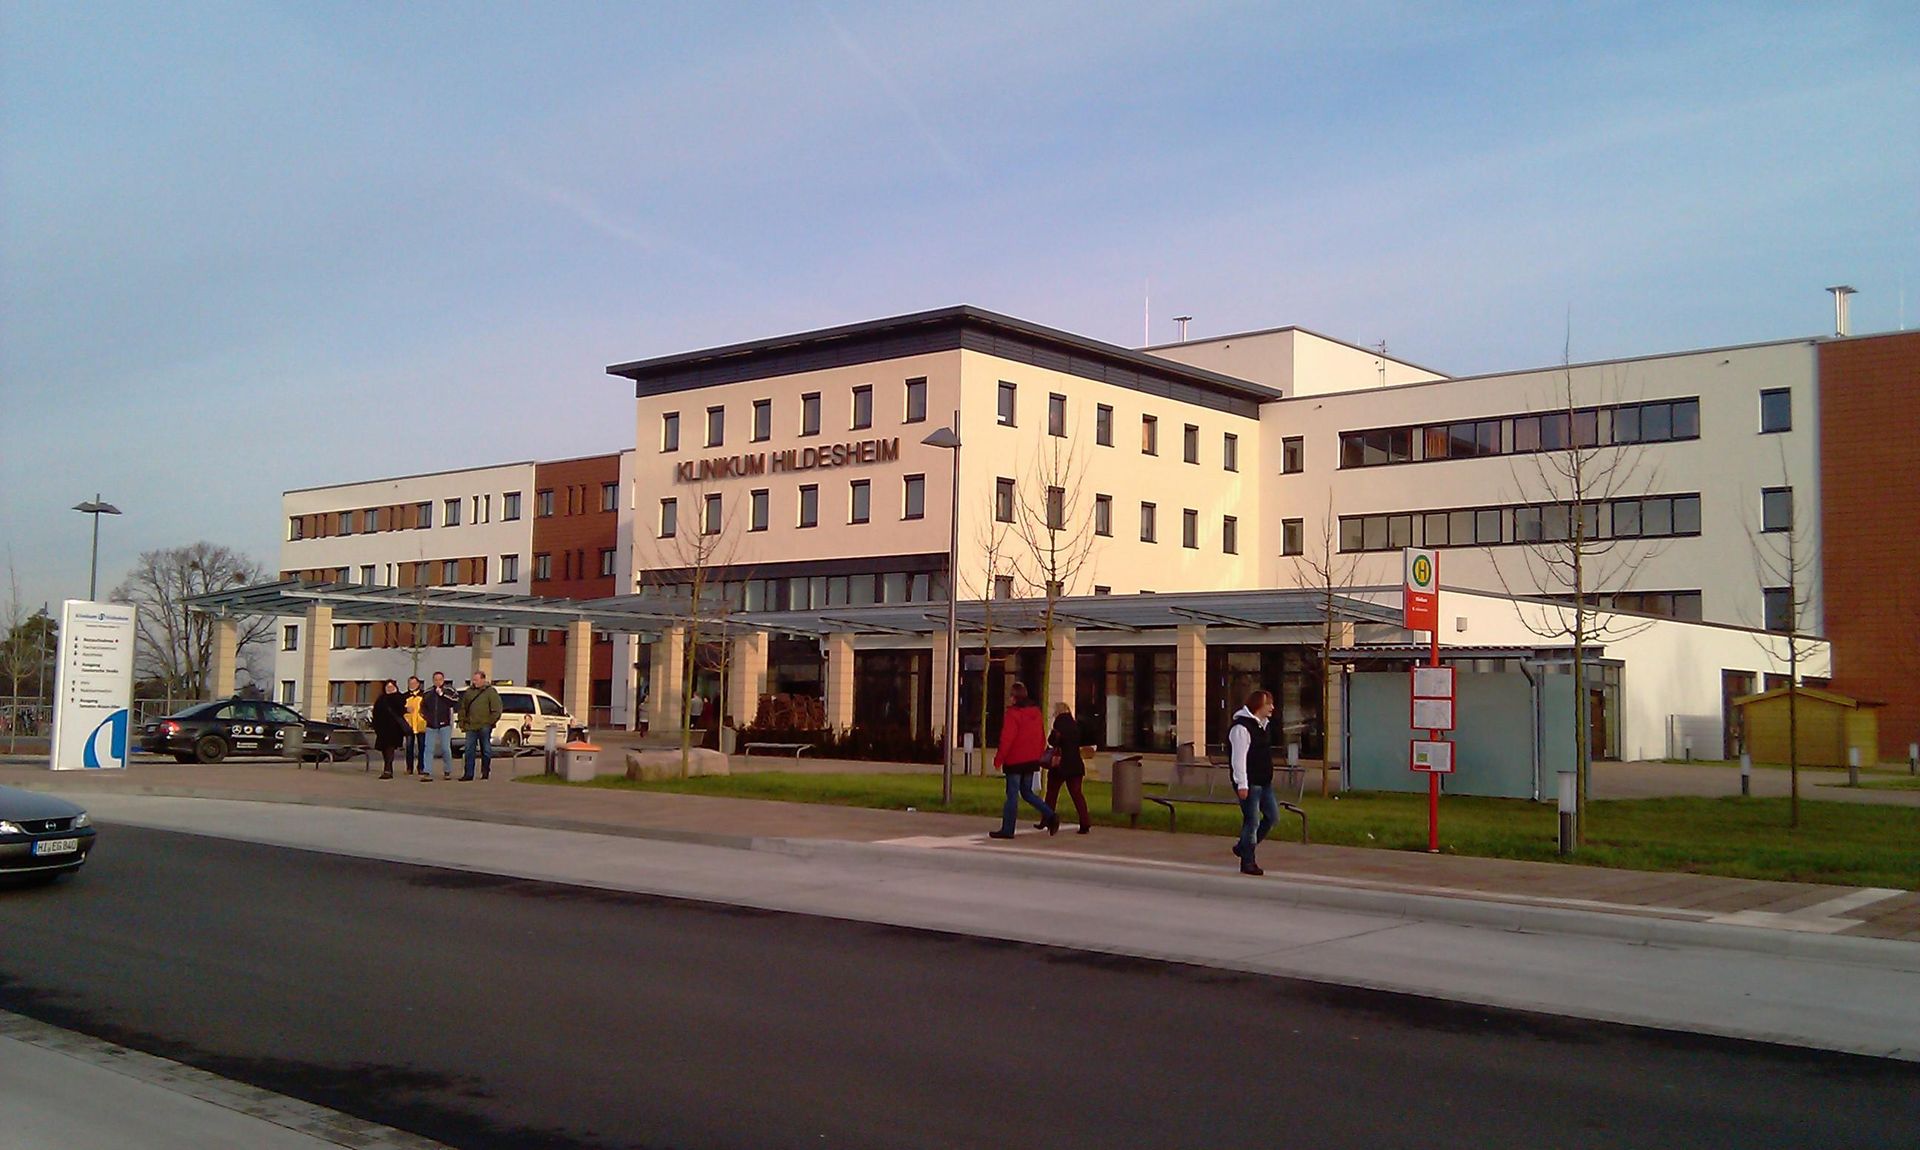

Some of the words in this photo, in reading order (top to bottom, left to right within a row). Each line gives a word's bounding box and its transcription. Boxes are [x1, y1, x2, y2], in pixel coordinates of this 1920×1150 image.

[677, 453, 766, 483] KLINIKUM
[772, 437, 900, 473] HILDESHEIM
[1417, 560, 1427, 582] H
